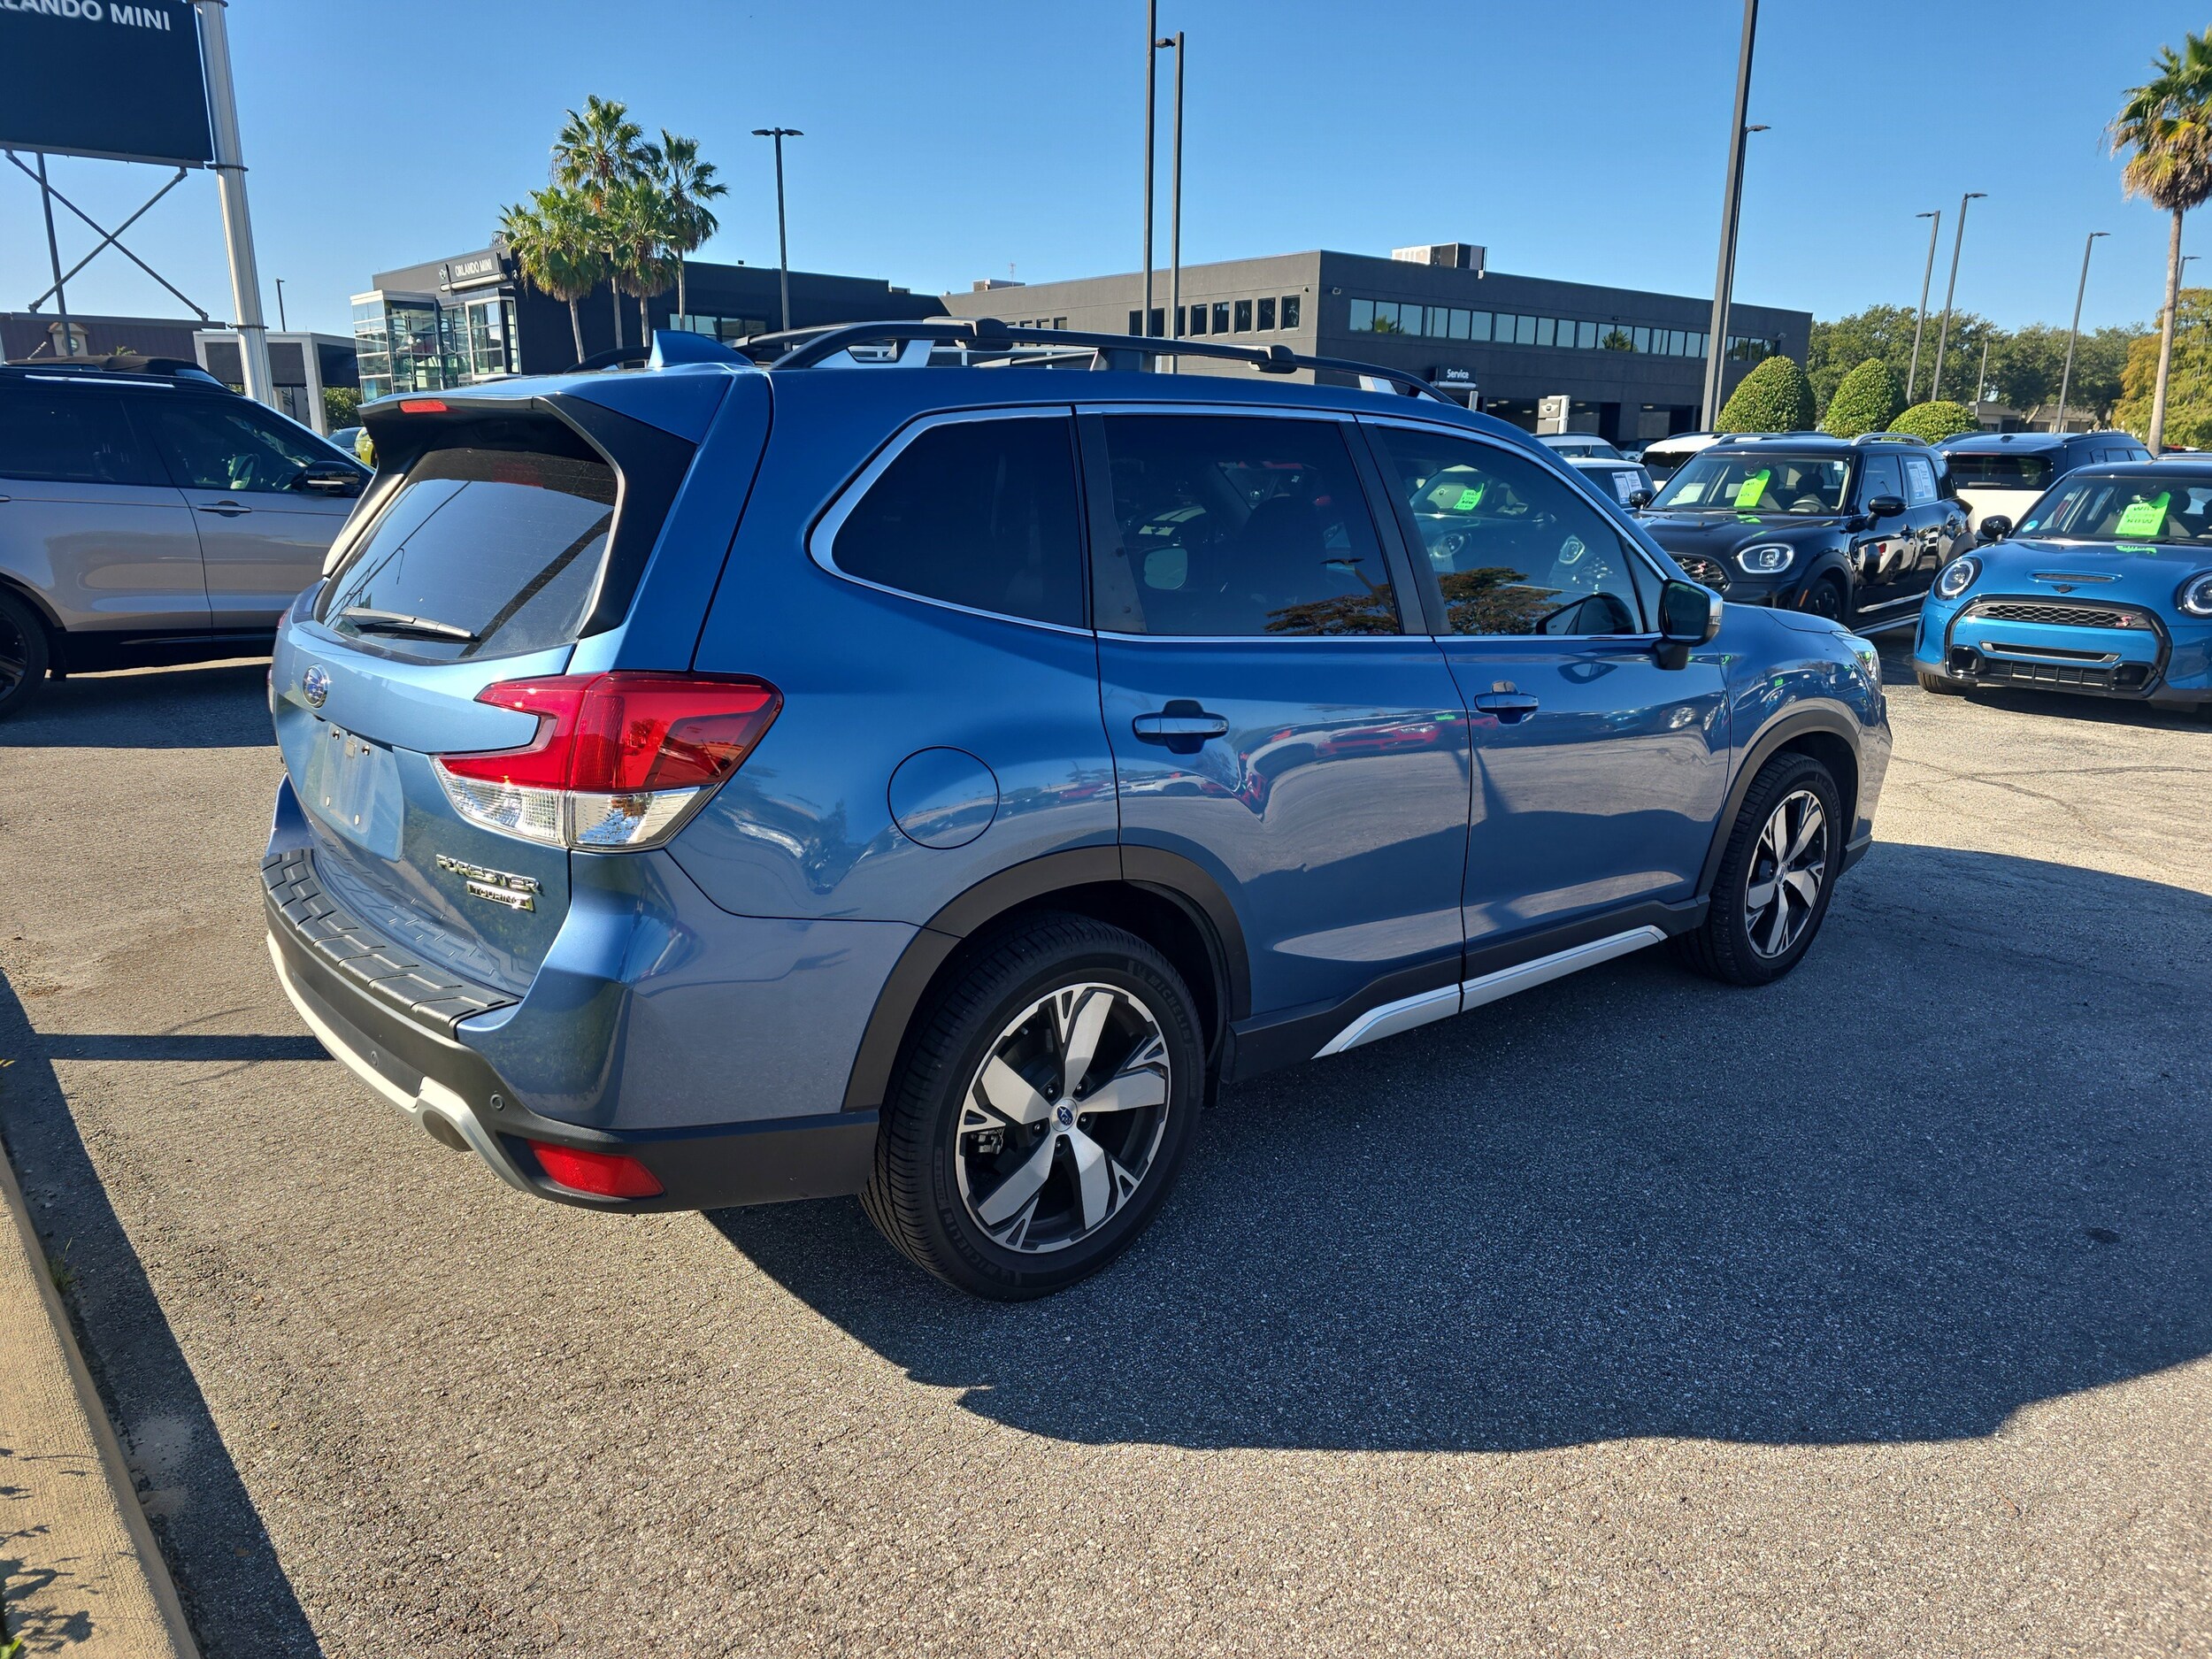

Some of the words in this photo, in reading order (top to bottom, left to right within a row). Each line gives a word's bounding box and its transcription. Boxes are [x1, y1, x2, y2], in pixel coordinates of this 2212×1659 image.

[111, 3, 171, 31] MINI
[455, 261, 479, 277] ORLANDO
[480, 257, 492, 272] MINI
[1447, 368, 1469, 380] Service
[1148, 974, 1192, 1044] MICHELIN
[942, 1212, 999, 1278] MICHELIN
